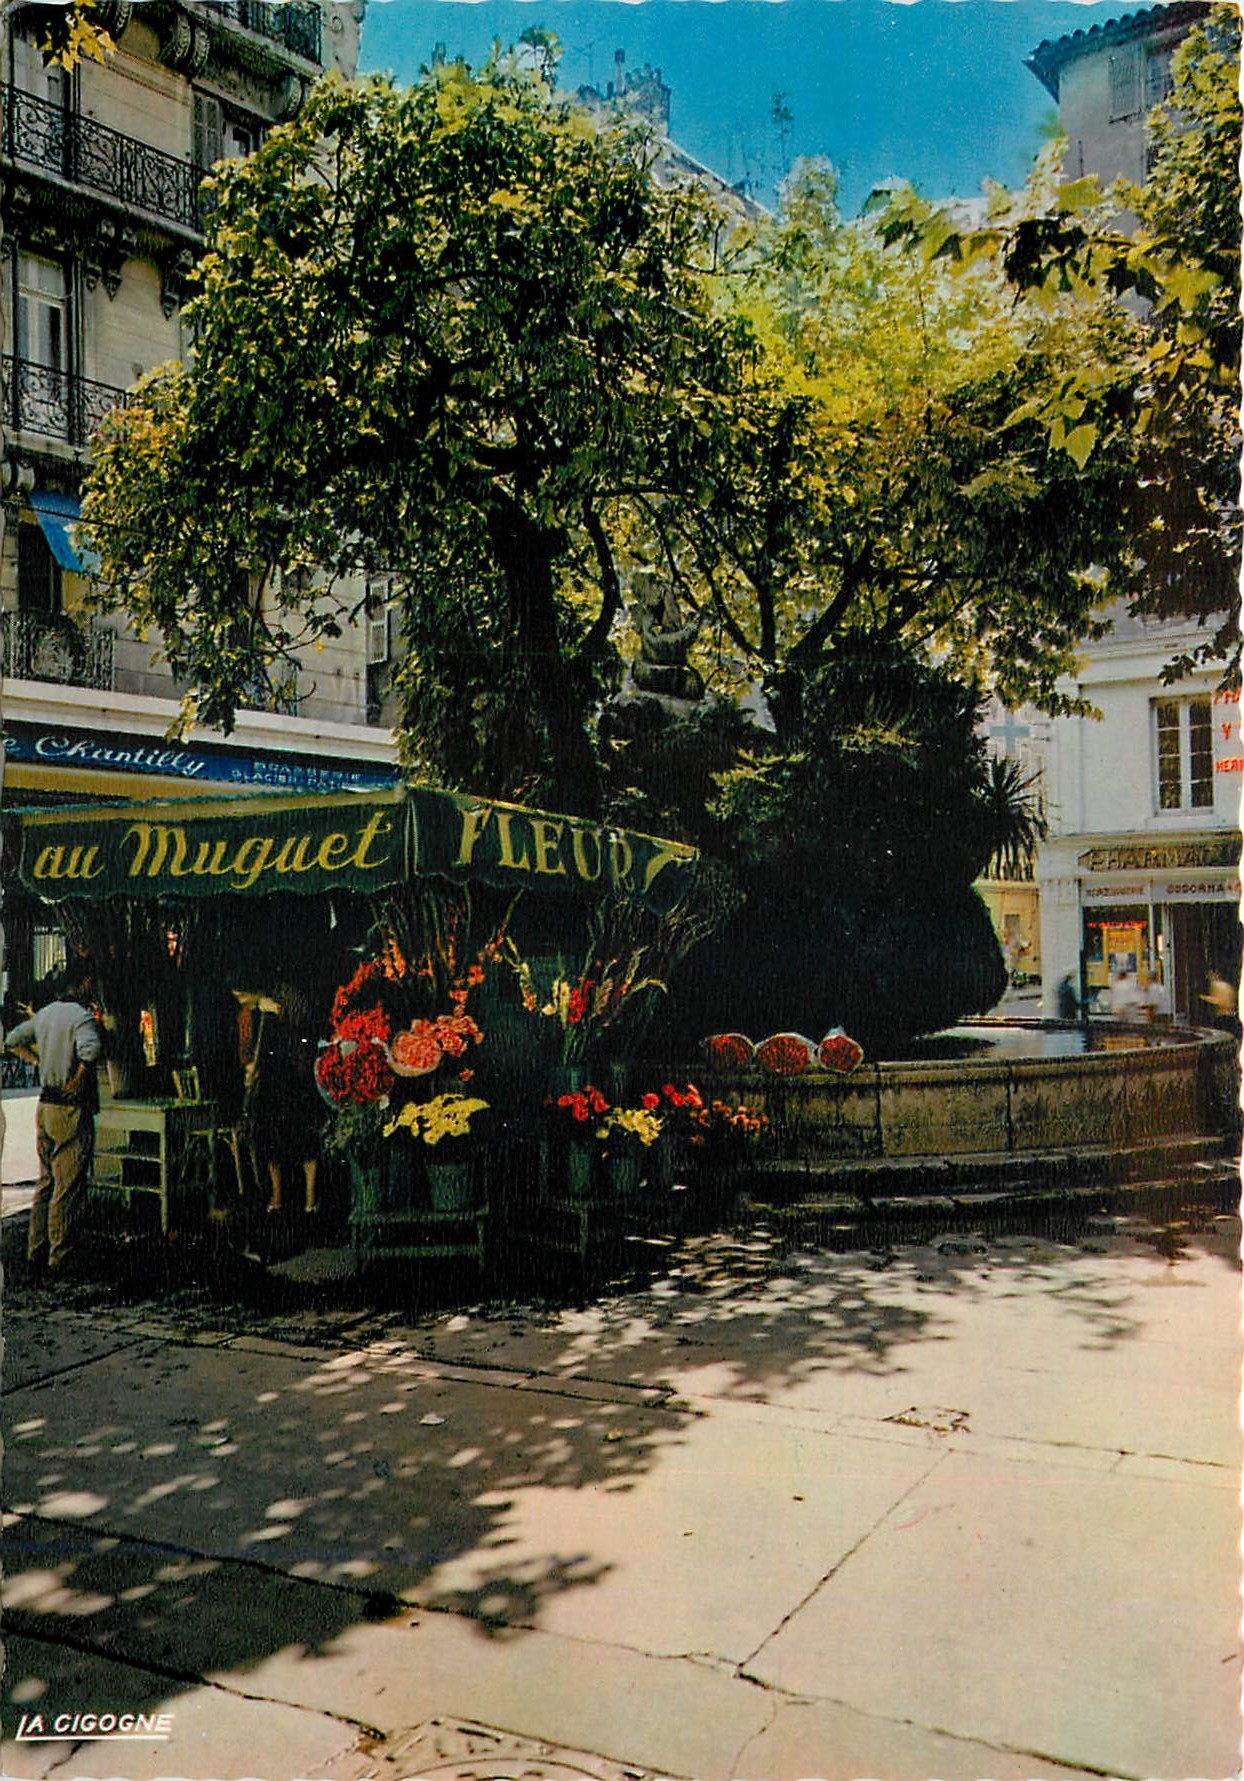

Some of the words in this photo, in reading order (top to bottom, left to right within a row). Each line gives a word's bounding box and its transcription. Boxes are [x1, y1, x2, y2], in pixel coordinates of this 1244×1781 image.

[35, 735, 205, 776] Chantilly
[33, 845, 106, 880] au
[119, 810, 393, 890] Muguet
